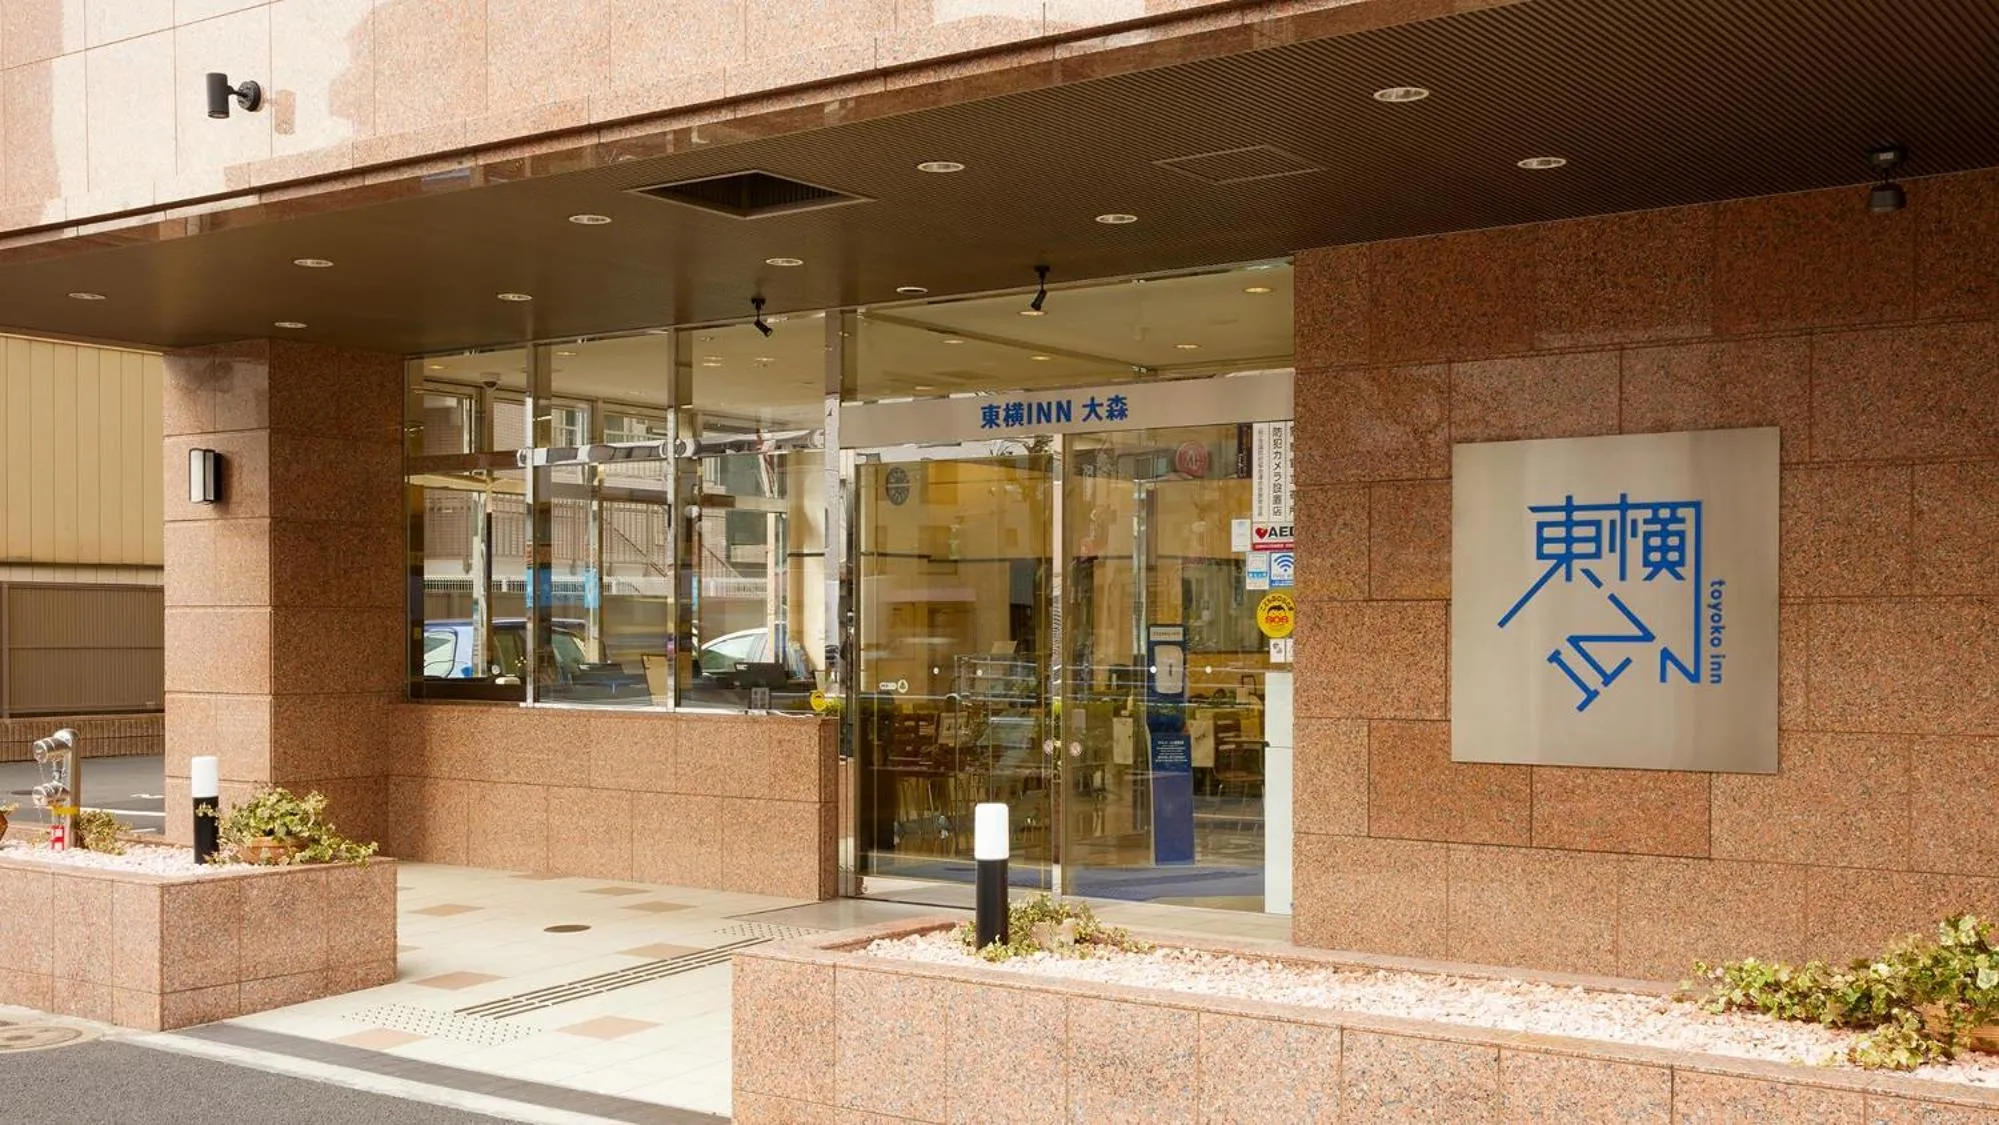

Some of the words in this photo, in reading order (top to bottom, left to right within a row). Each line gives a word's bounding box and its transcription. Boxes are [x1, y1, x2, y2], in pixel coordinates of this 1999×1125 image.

[980, 400, 1072, 428] 東横INN
[1082, 394, 1129, 422] 大森
[1708, 579, 1726, 648] toyoko
[1709, 653, 1726, 685] inn
